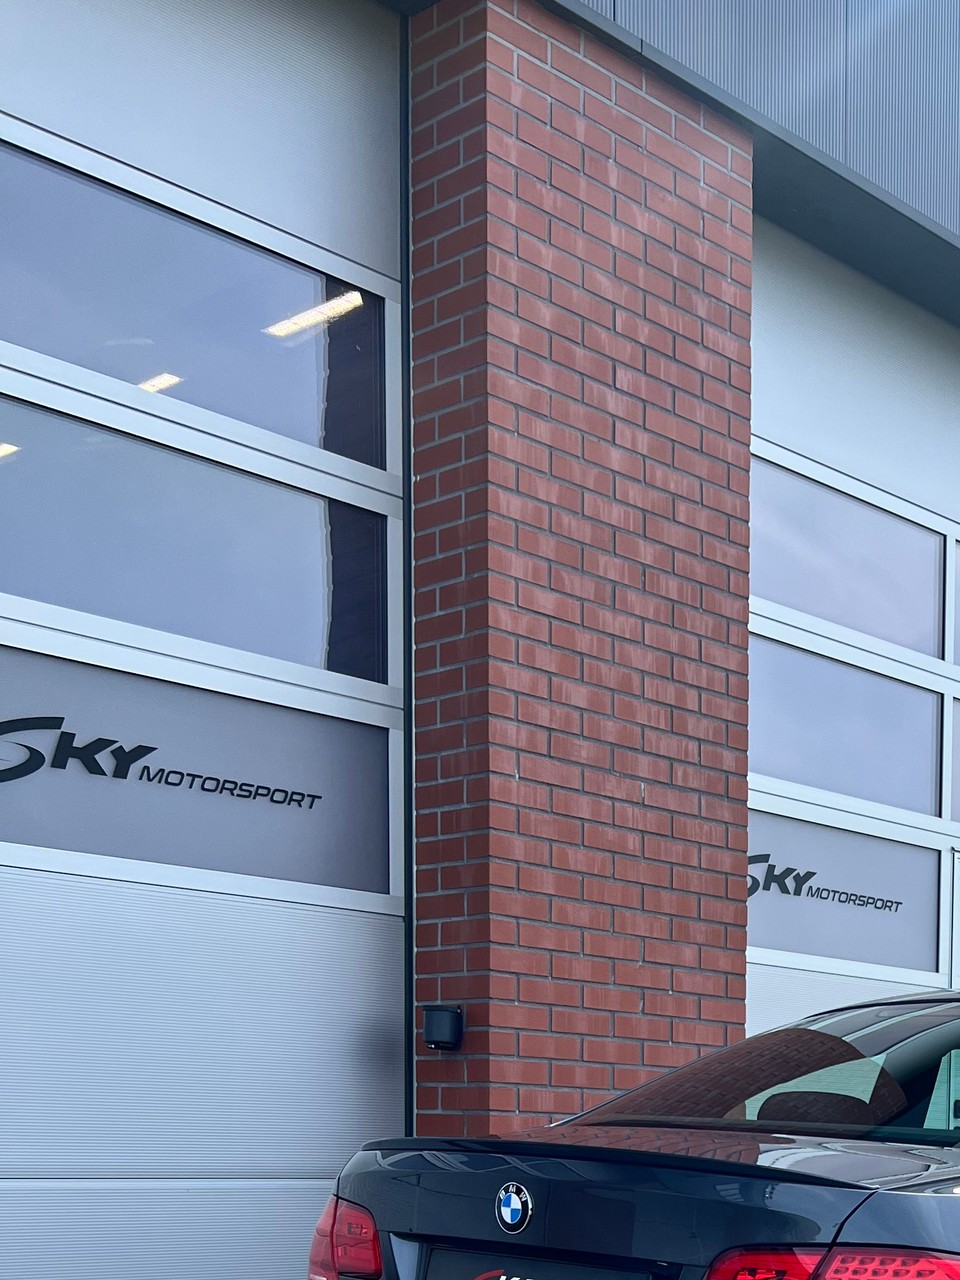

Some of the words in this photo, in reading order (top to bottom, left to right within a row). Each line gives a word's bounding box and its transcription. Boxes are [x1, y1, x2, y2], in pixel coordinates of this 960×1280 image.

[138, 765, 323, 810] MOTORSPORT
[806, 885, 903, 913] MOTORSPORT
[499, 1184, 528, 1202] BMW
